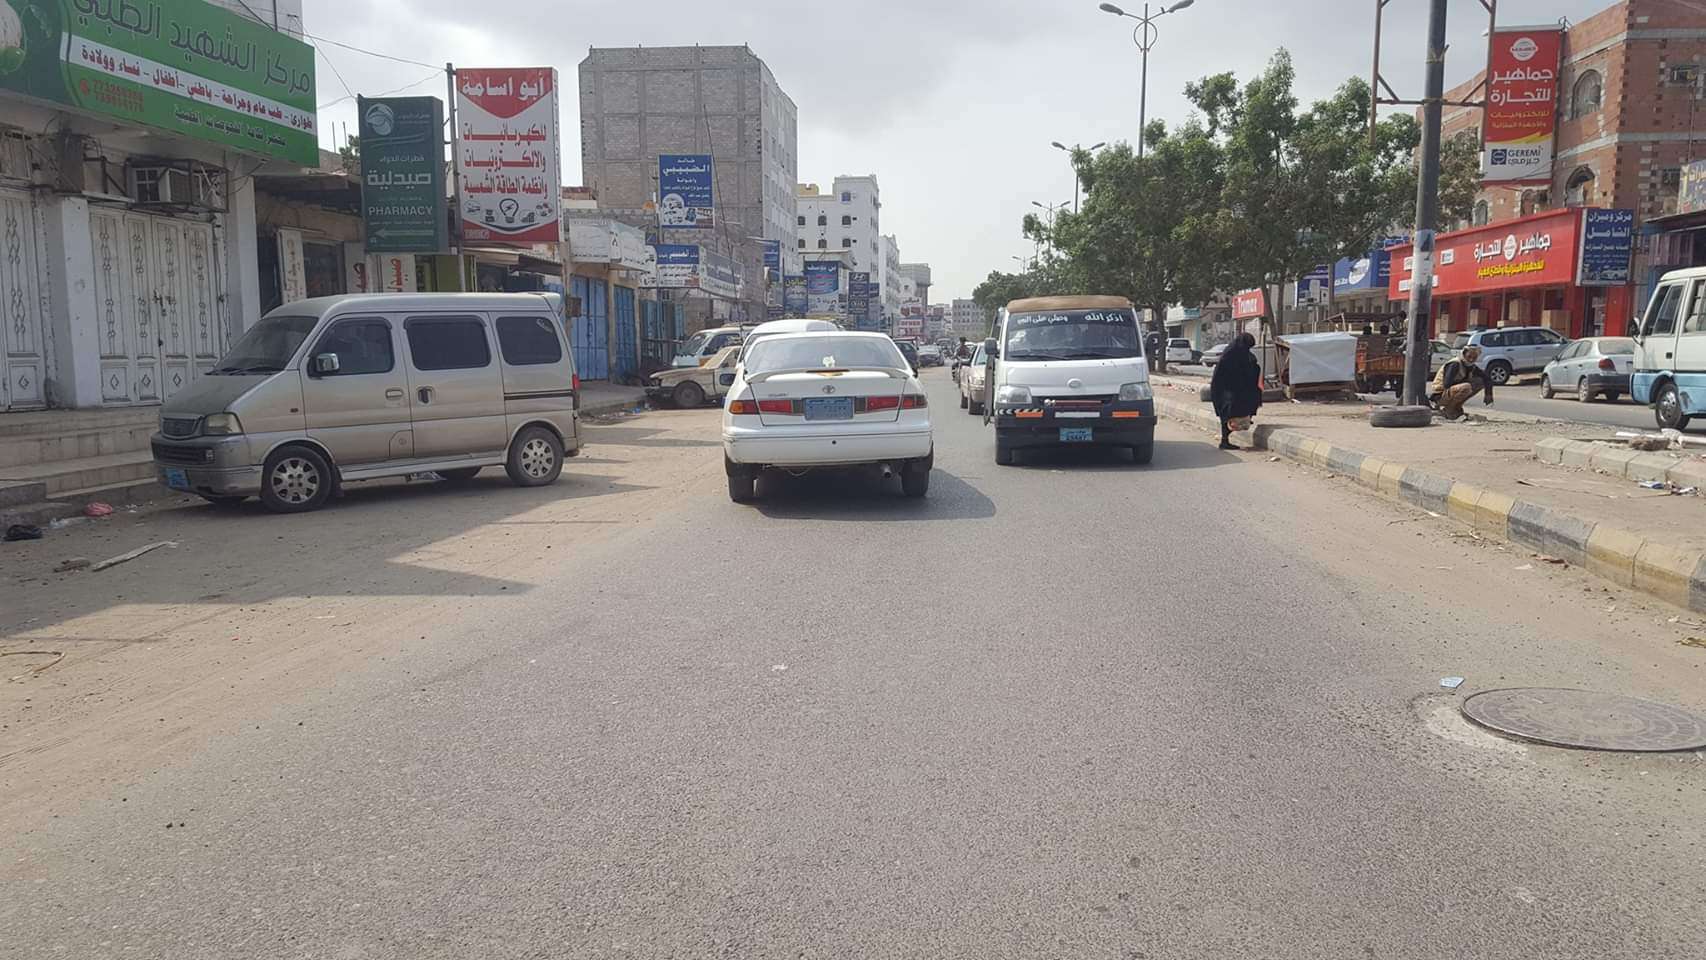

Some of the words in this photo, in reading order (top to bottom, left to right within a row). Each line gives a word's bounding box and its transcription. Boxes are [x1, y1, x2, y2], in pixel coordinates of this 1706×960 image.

[74, 0, 161, 40] الطبي
[169, 21, 256, 73] الشهيد
[81, 44, 115, 72] وولادة
[118, 57, 141, 77] نساء
[152, 68, 179, 89] أطفال
[264, 50, 310, 94] مركز
[1491, 66, 1553, 85] جماهير
[462, 75, 513, 97] اسامة
[517, 71, 545, 101] أبو
[1490, 87, 1551, 106] للتجارة
[367, 169, 432, 190] صيدلية
[463, 172, 496, 199] الشمسية
[496, 174, 521, 194] الطاقة
[368, 205, 433, 216] PHARMACY
[1614, 210, 1633, 223] مركز
[1518, 231, 1551, 255] جماهير
[1586, 226, 1630, 239] الشامل
[1473, 239, 1502, 264] للتجارة
[1084, 312, 1104, 321] الله
